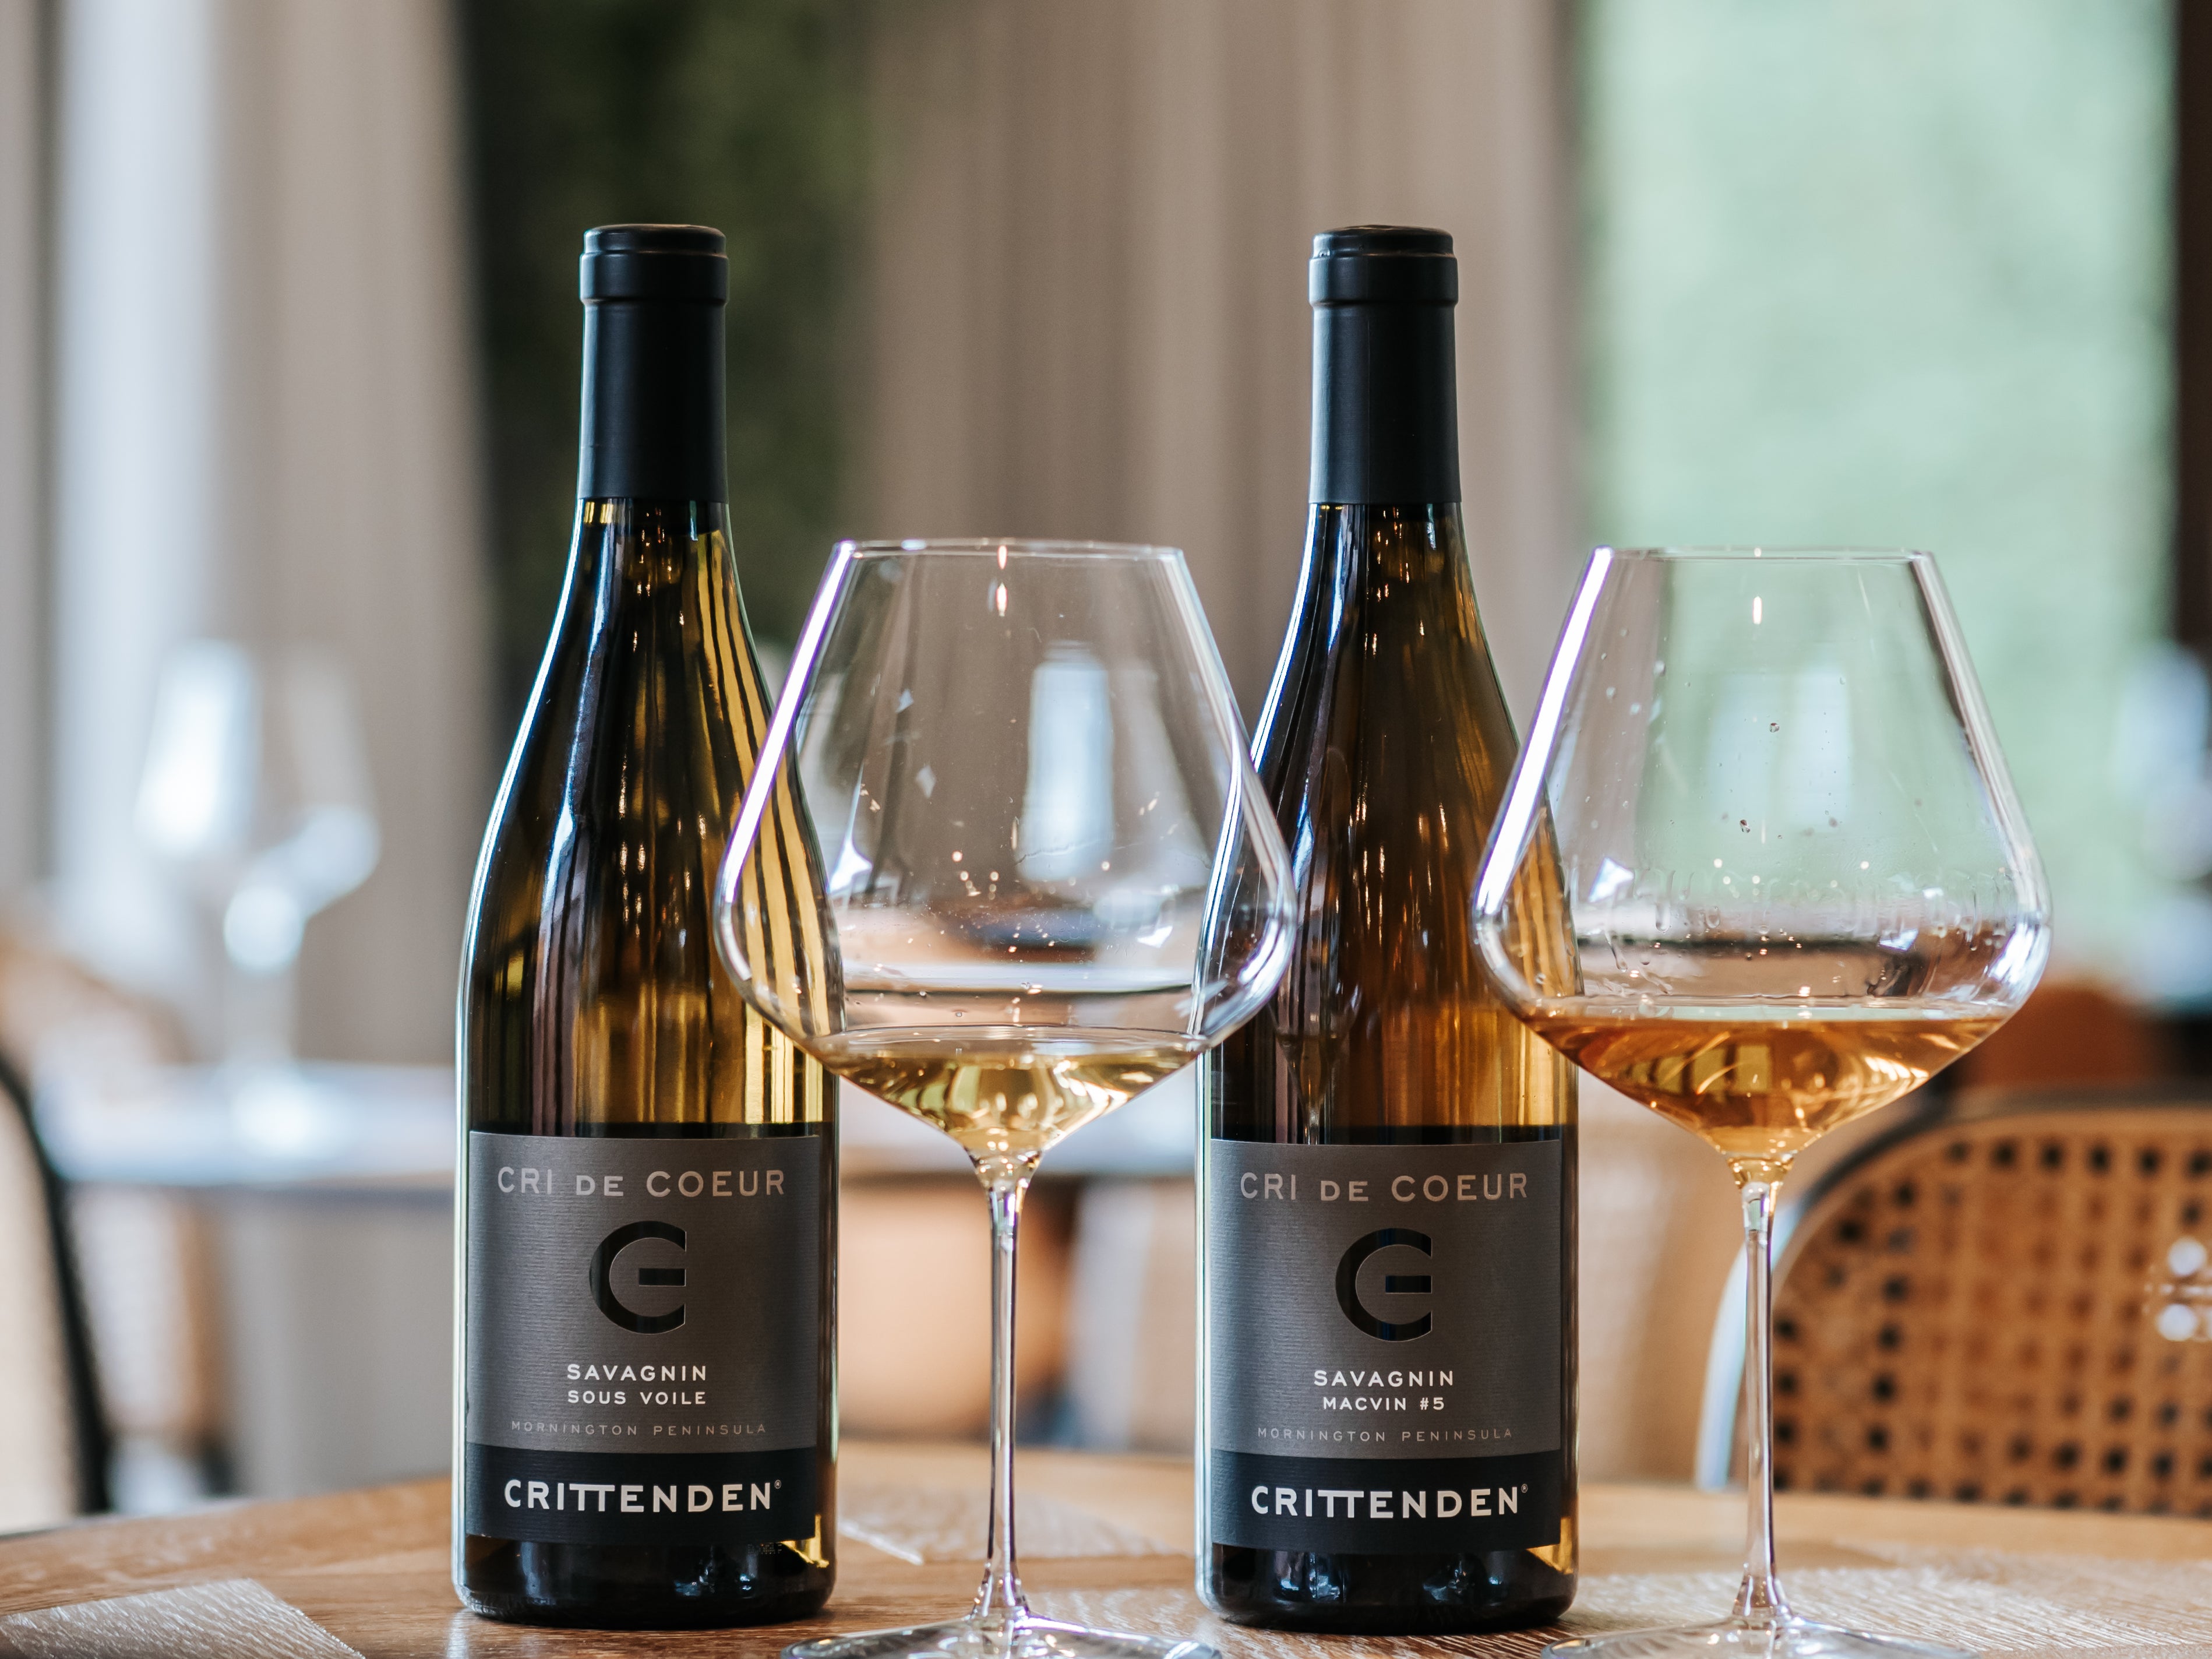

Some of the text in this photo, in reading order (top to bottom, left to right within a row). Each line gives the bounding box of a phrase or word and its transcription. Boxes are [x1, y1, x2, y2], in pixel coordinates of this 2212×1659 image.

[498, 1166, 785, 1198] CRI DE COEUR
[1240, 1172, 1528, 1203] CRI DE COEUR
[567, 1364, 707, 1382] SAVAGNIN
[1313, 1370, 1454, 1387] SAVAGNIN
[567, 1390, 706, 1405] SOUS VOILE
[1323, 1397, 1445, 1411] MACVIN #5
[511, 1420, 767, 1436] MORNINGTON PENINSULA
[1257, 1427, 1512, 1442] MORNINGTON PENINSULA
